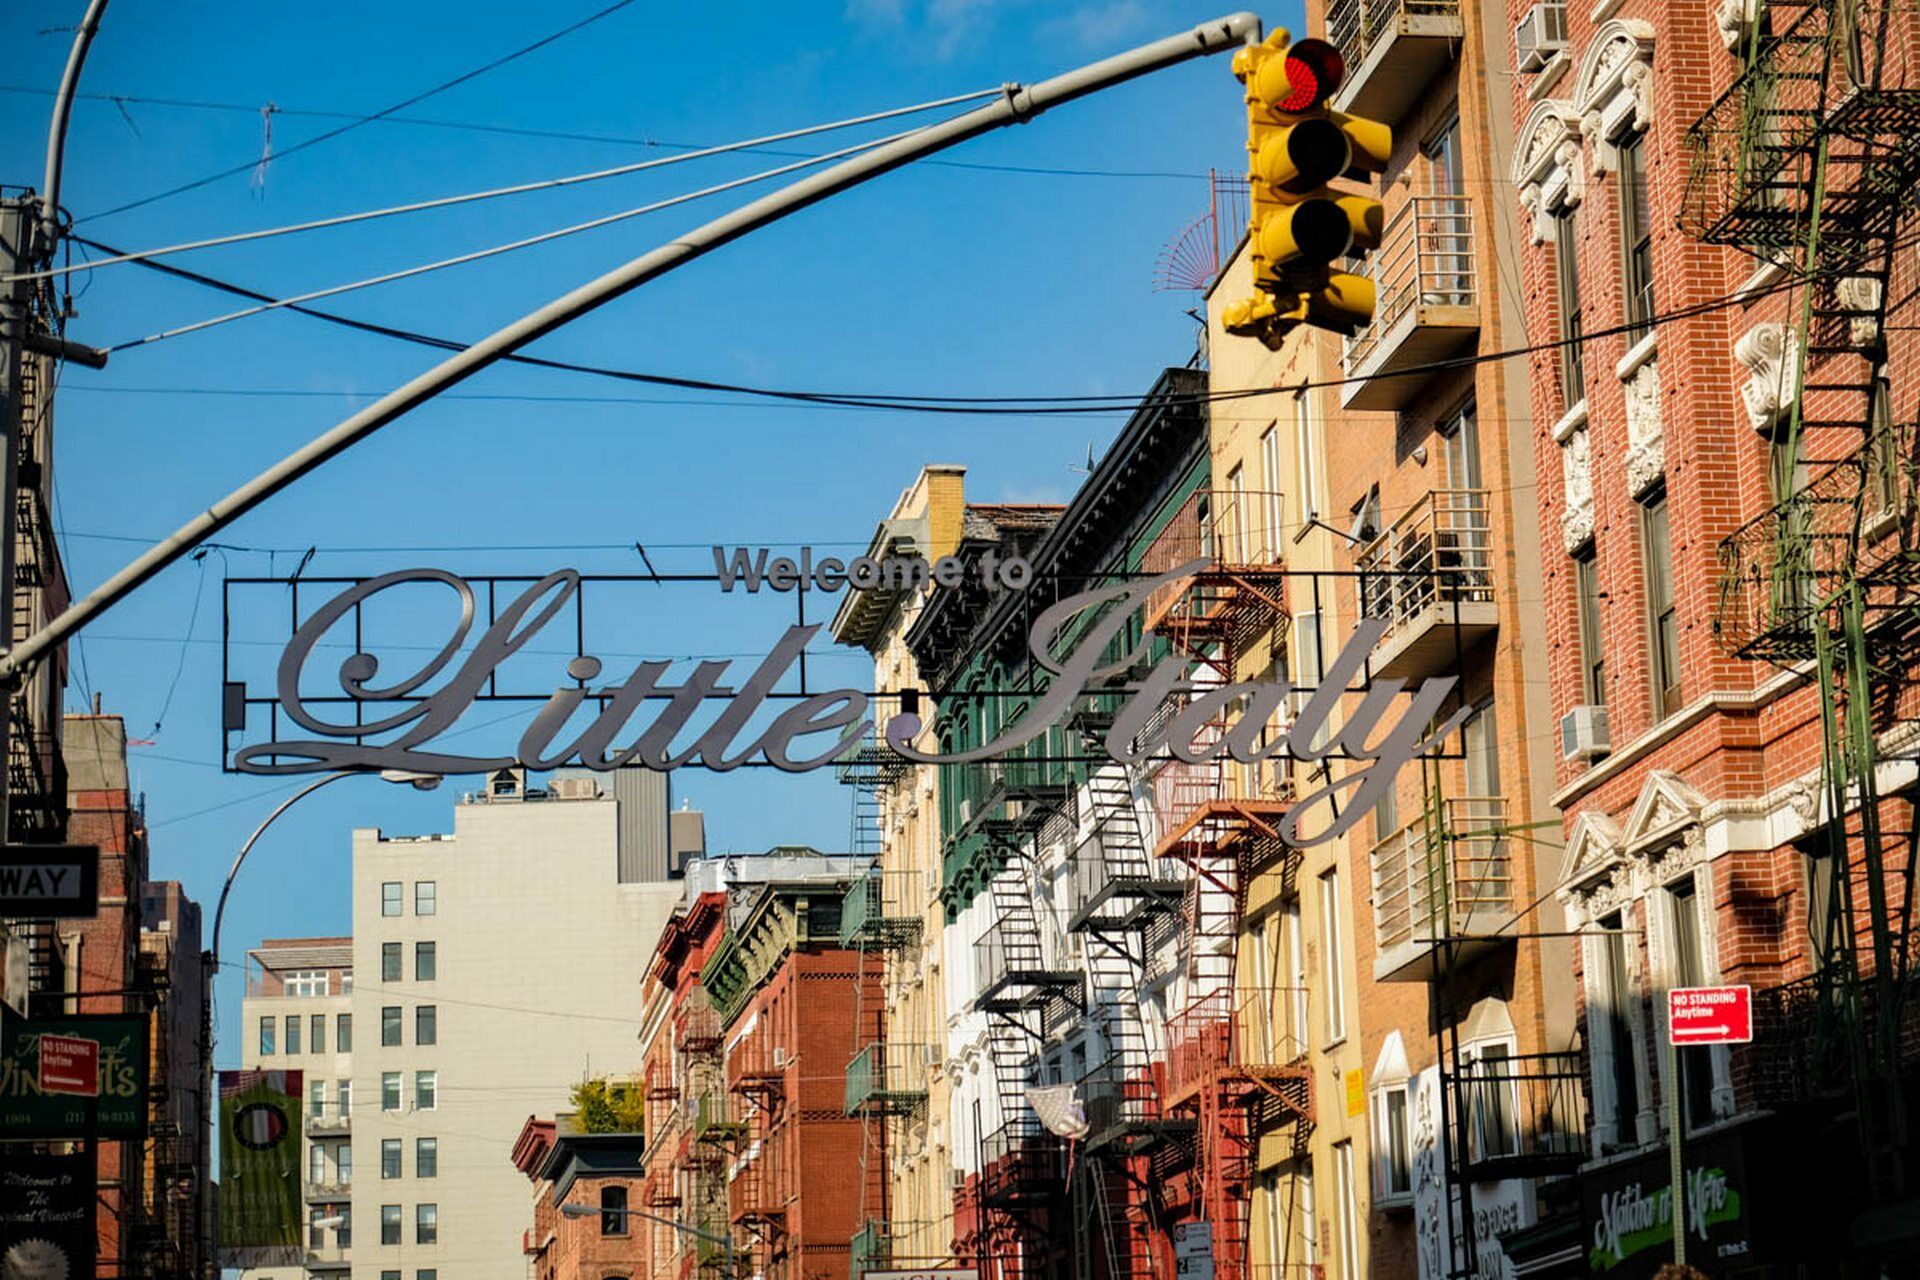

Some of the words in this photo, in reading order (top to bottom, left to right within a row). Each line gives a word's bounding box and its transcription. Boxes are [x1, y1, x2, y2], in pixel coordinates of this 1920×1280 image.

[712, 545, 966, 594] Welcome
[980, 552, 1035, 591] to
[234, 567, 873, 776] Little
[885, 556, 1474, 849] Italy
[0, 868, 67, 896] WAY
[1673, 994, 1688, 1006] NO
[1689, 992, 1737, 1005] STANDING
[1674, 1006, 1714, 1019] Anytime
[43, 1040, 55, 1052] NO
[55, 1042, 90, 1056] STANDING
[43, 1053, 73, 1067] Anytime
[4, 1171, 57, 1187] Welcome
[26, 1190, 50, 1206] The
